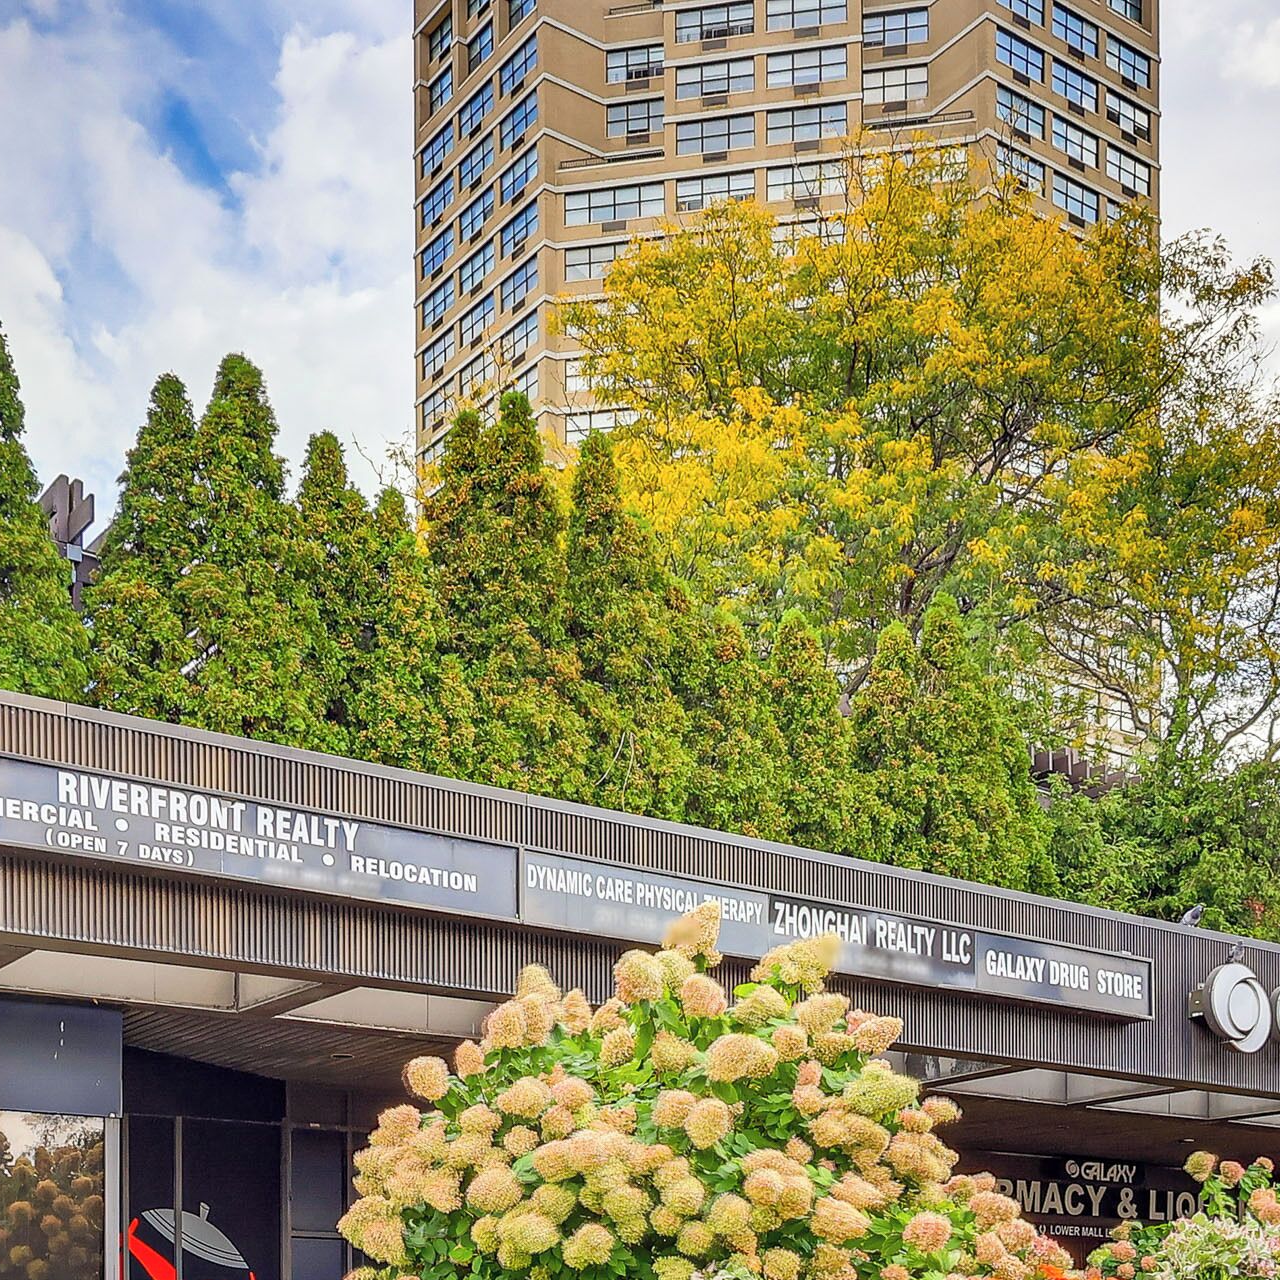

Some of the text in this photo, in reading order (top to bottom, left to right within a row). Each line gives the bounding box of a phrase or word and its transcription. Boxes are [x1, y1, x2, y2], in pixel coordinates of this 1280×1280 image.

[58, 771, 360, 852] RIVERFRONT REALTY
[45, 827, 194, 867] (OPEN 7 DAYS)
[154, 822, 304, 864] RESIDENTIAL
[351, 854, 477, 893] RELOCATION
[527, 864, 592, 897] DYNAMIC
[596, 876, 633, 903] CARE
[636, 883, 698, 914] PHYSICAL
[774, 902, 868, 945] ZHONGHAI
[875, 919, 936, 957] REALTY
[942, 930, 971, 964] LLC
[985, 949, 1142, 1000] GALAXY DRUG STORE
[1081, 1161, 1136, 1184] GALAXY
[1117, 1187, 1138, 1219] &
[1149, 1189, 1205, 1222] LIQ
[1050, 1224, 1080, 1237] LOWER
[1081, 1225, 1104, 1238] MALL
